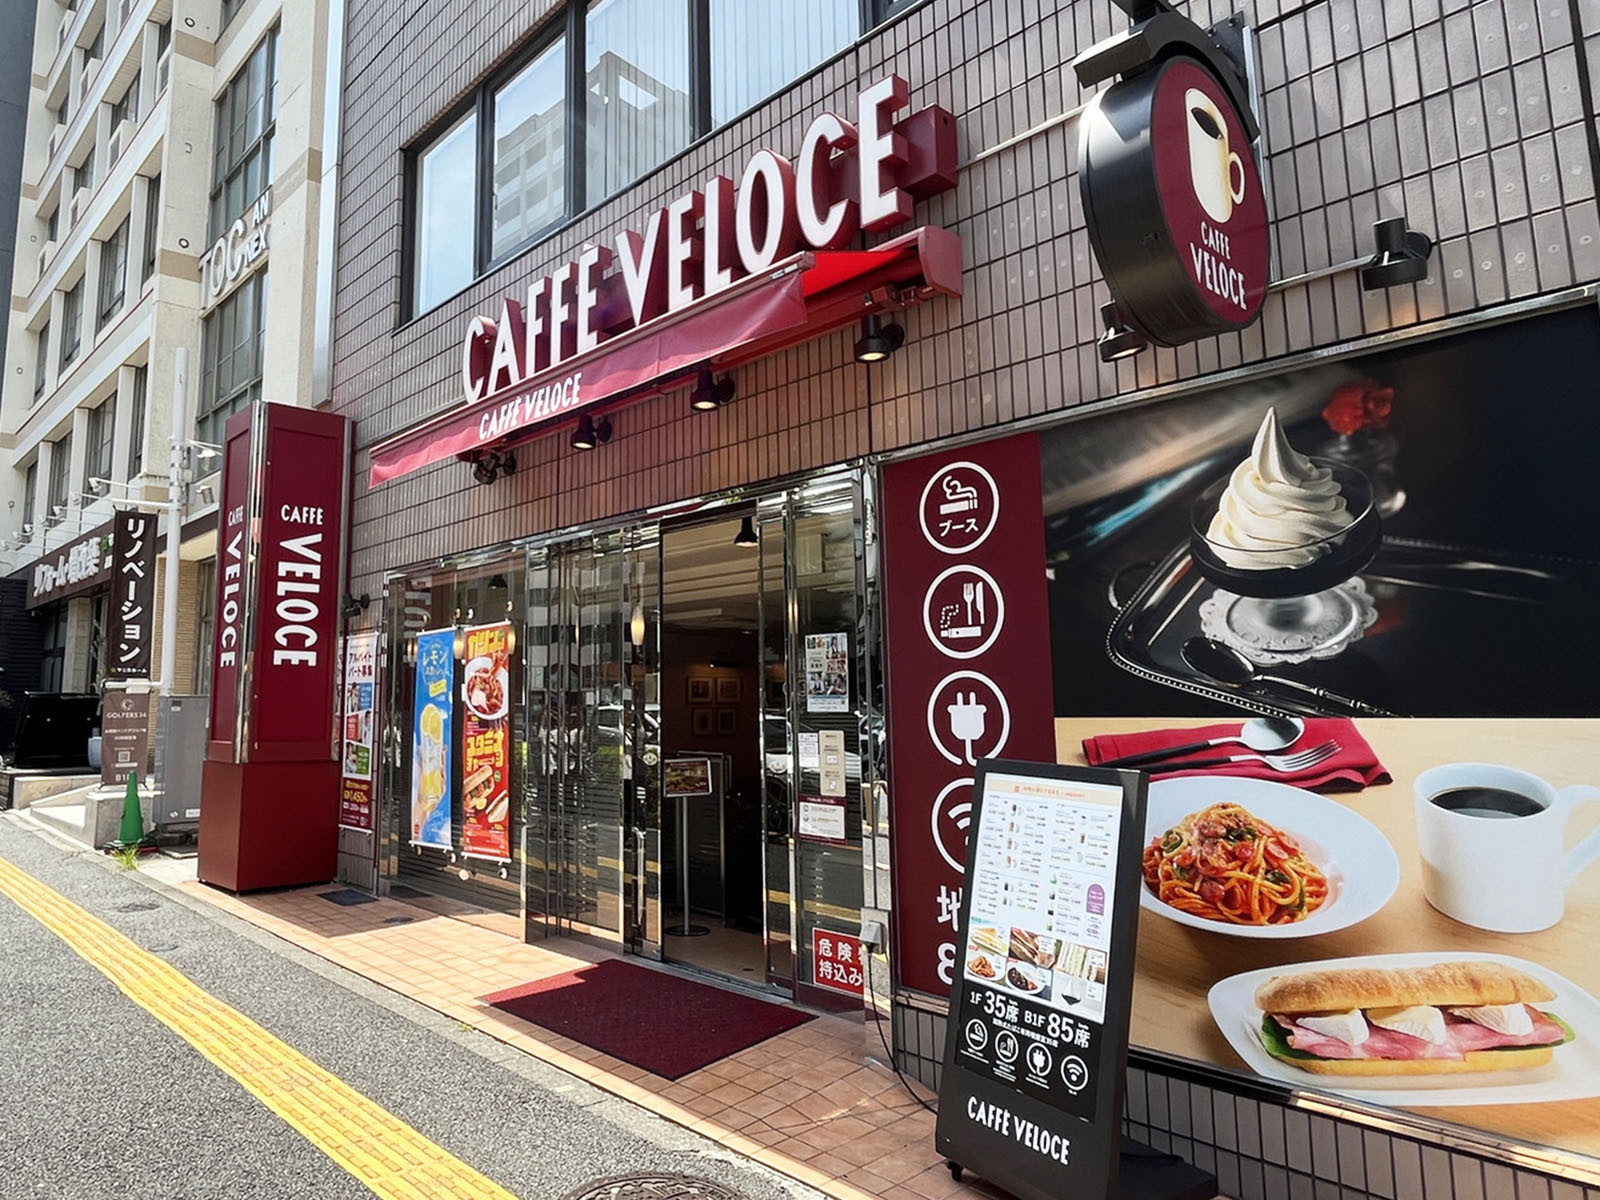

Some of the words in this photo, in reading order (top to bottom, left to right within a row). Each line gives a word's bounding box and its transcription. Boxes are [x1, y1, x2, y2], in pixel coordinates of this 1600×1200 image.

[253, 189, 272, 229] AN
[615, 73, 905, 328] VELOCE
[198, 218, 246, 309] TOC
[244, 224, 270, 267] NEX
[1190, 242, 1247, 310] VELOCE
[525, 372, 582, 421] VELOCE
[939, 518, 979, 537] ブース
[119, 518, 146, 663] リノベーション
[220, 530, 243, 667] VELOCE
[273, 533, 323, 666] VELOCE
[422, 649, 448, 667] レモン
[818, 937, 864, 966] 危険
[970, 991, 983, 1005] 1F
[1024, 1010, 1046, 1028] B1F
[1013, 1115, 1071, 1166] VELOCE
